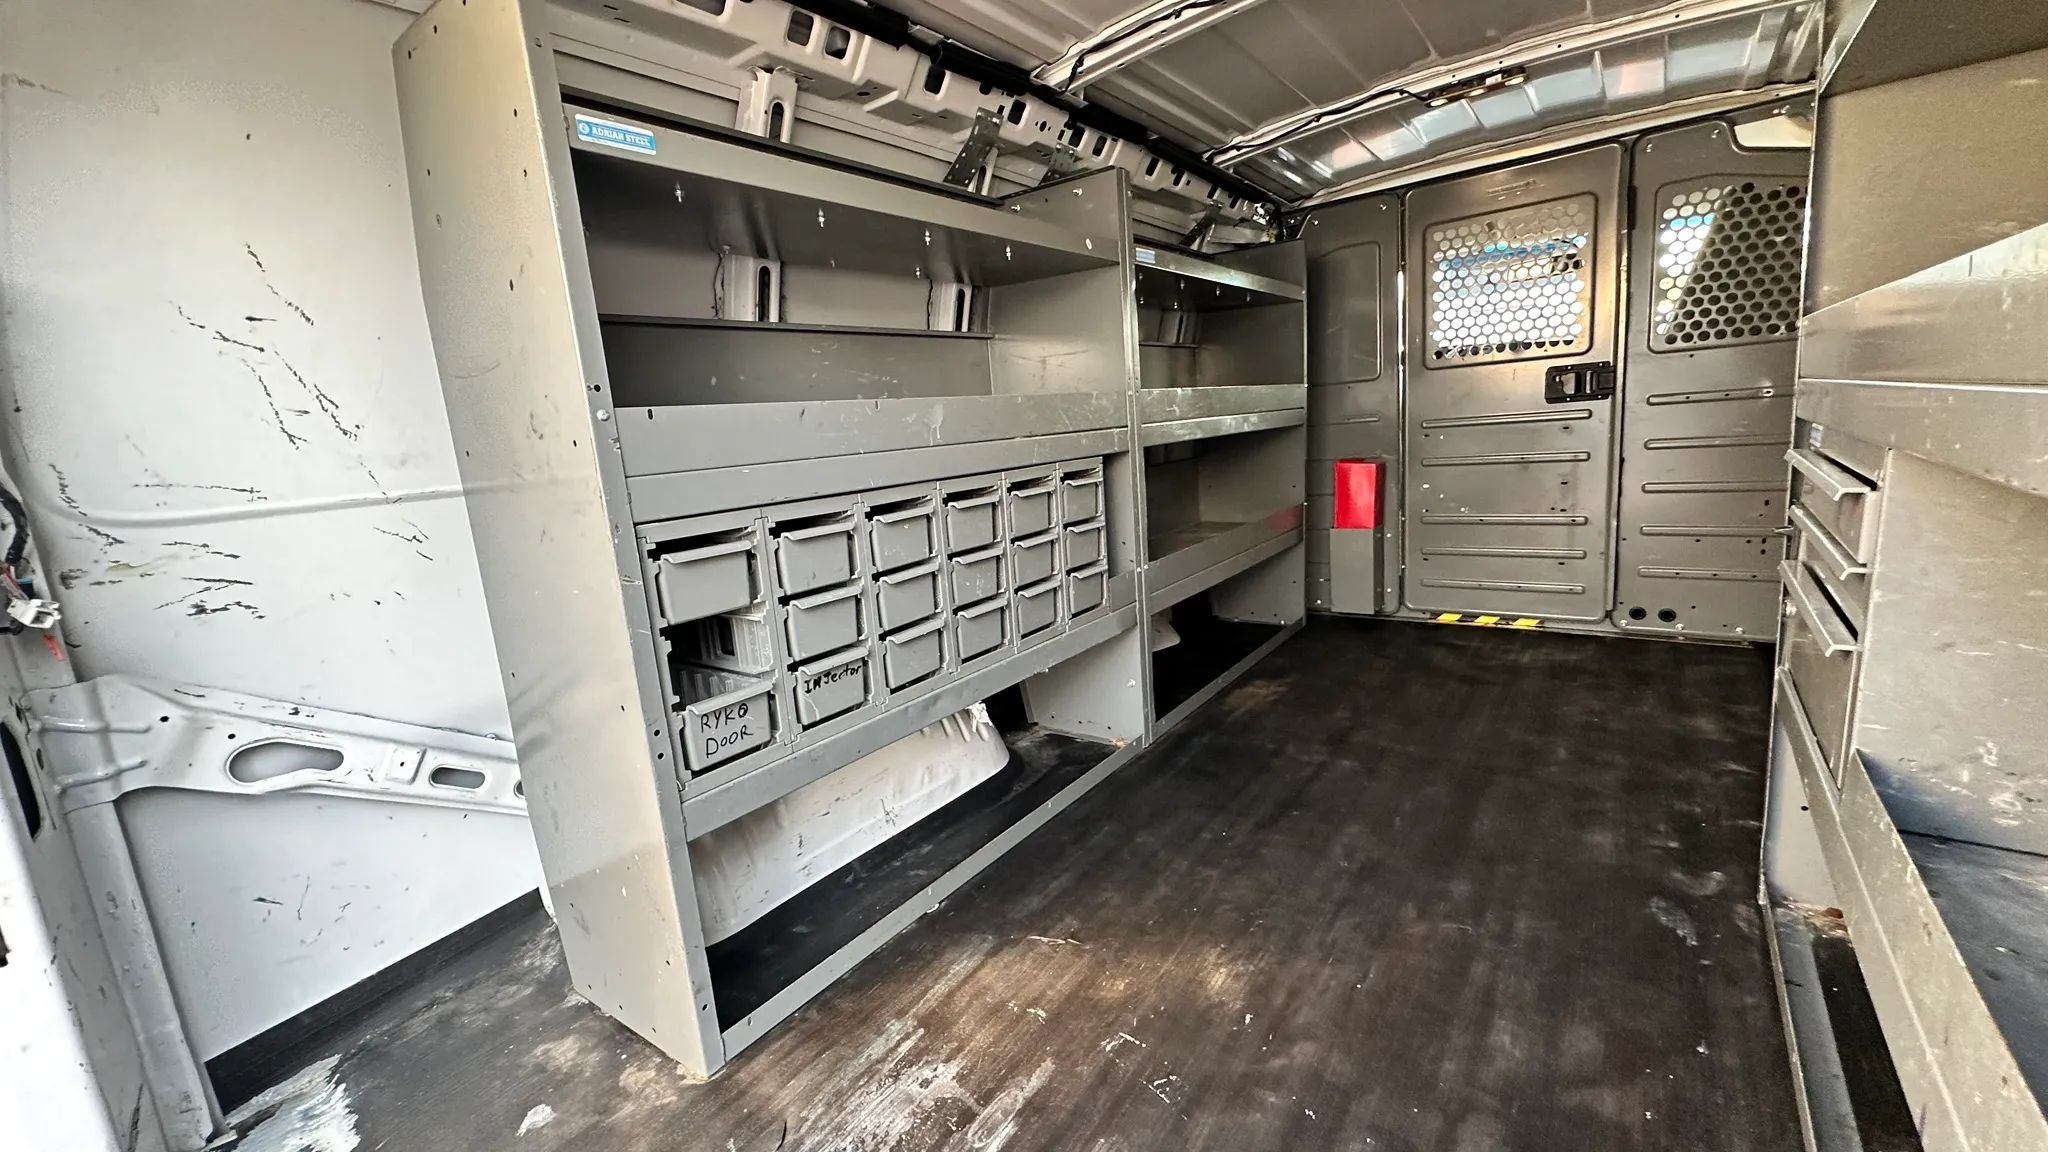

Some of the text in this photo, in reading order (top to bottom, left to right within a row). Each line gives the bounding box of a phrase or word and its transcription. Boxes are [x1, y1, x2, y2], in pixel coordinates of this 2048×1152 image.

[592, 126, 651, 146] ADRIAN STEEL
[706, 724, 754, 759] DOOR
